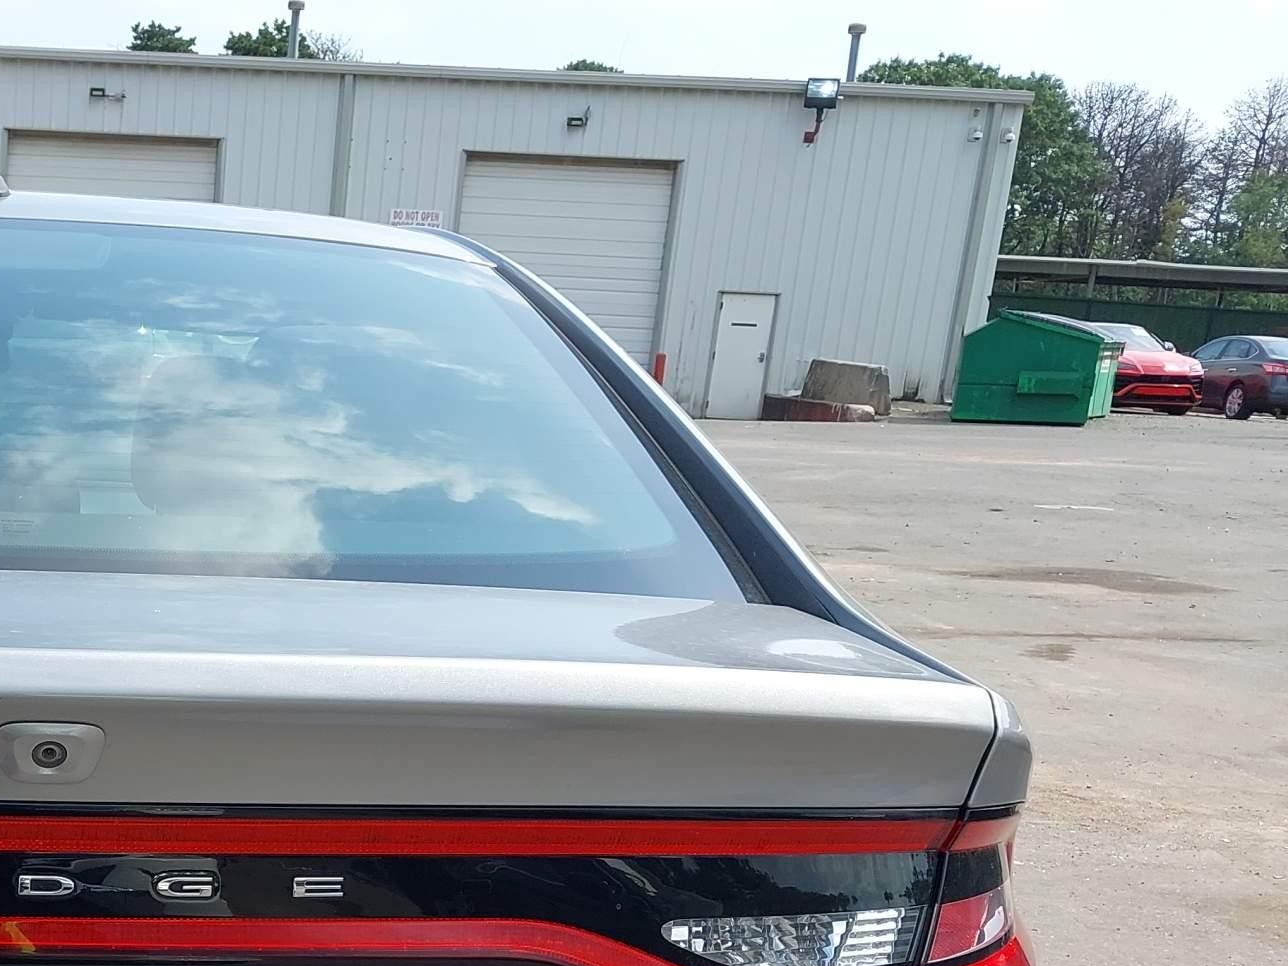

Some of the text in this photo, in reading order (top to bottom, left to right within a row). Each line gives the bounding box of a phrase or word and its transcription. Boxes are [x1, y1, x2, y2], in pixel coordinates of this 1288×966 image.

[392, 210, 440, 222] DO NOT OPEN
